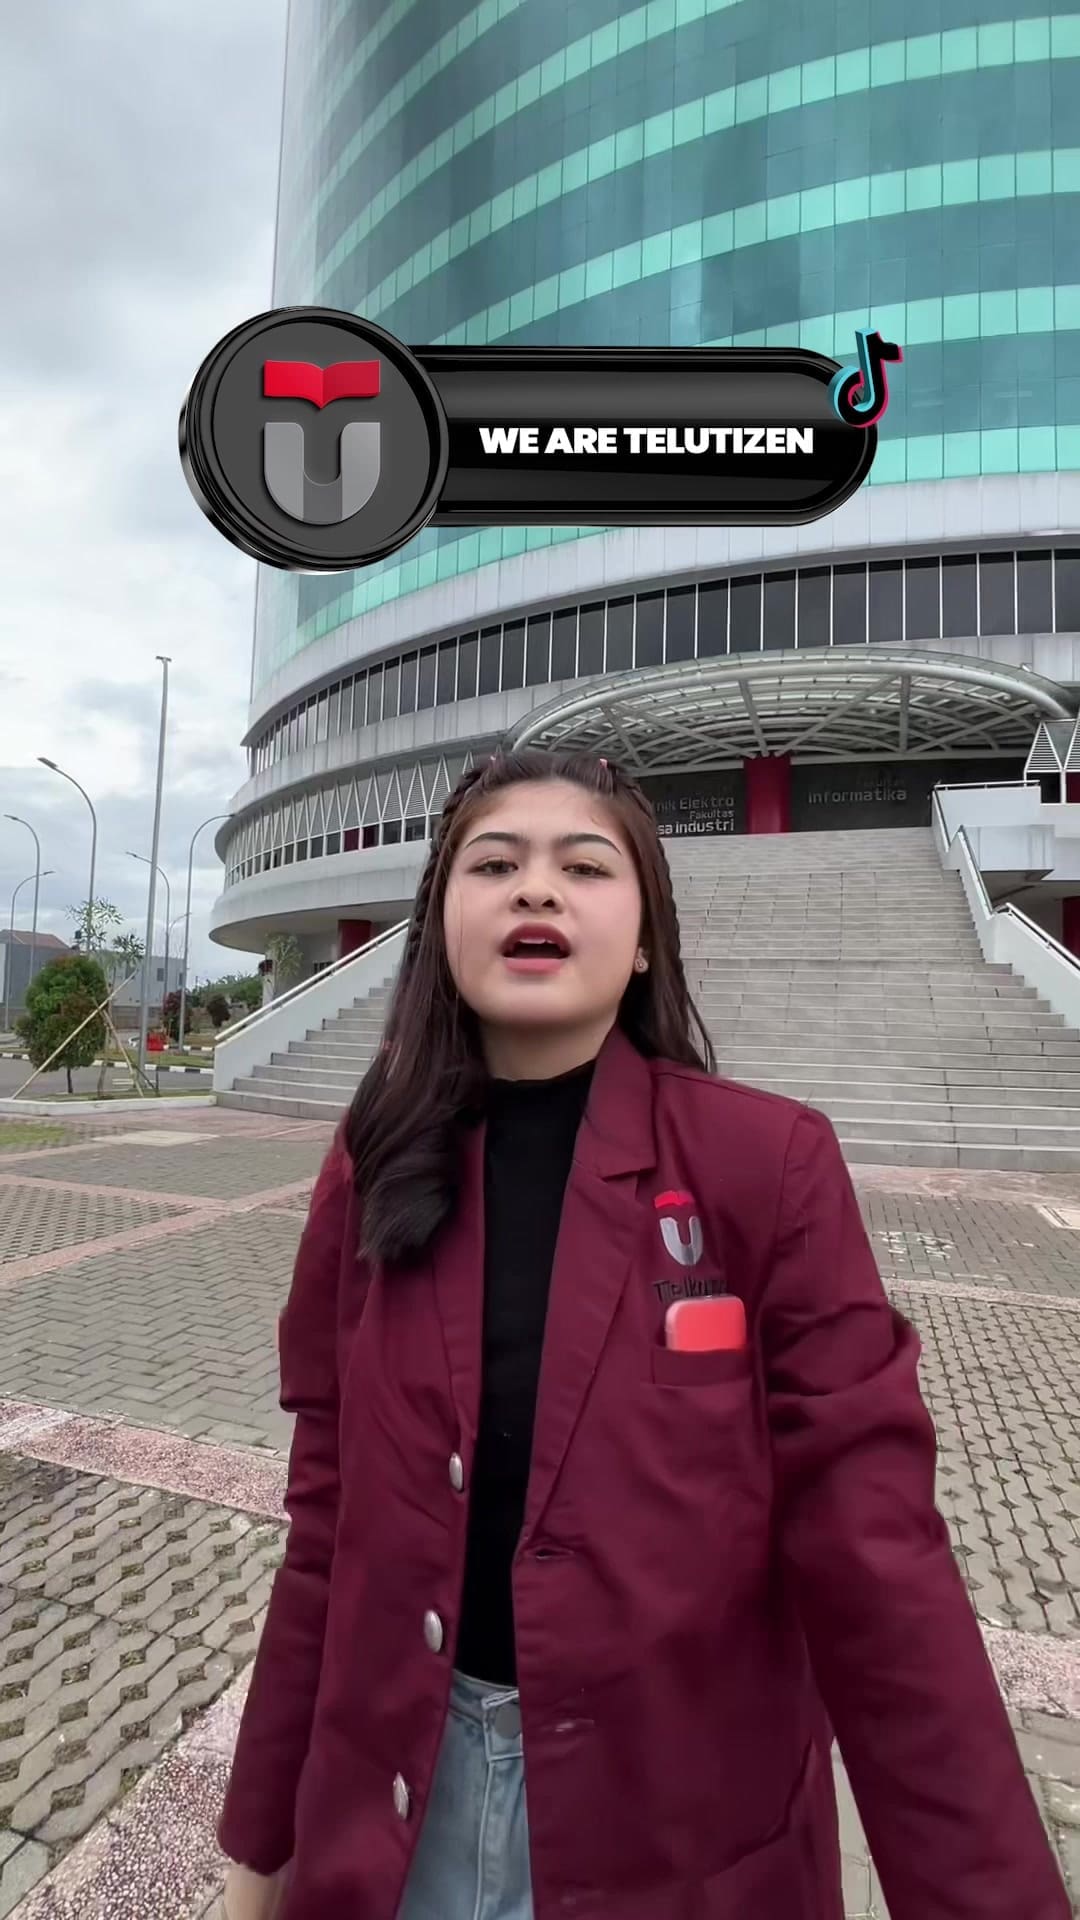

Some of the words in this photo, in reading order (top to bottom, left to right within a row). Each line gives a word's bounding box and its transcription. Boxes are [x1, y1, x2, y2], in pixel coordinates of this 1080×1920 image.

[679, 795, 735, 811] Elektro
[808, 788, 908, 804] informatika
[689, 808, 735, 821] Fakultas
[675, 817, 735, 835] industri
